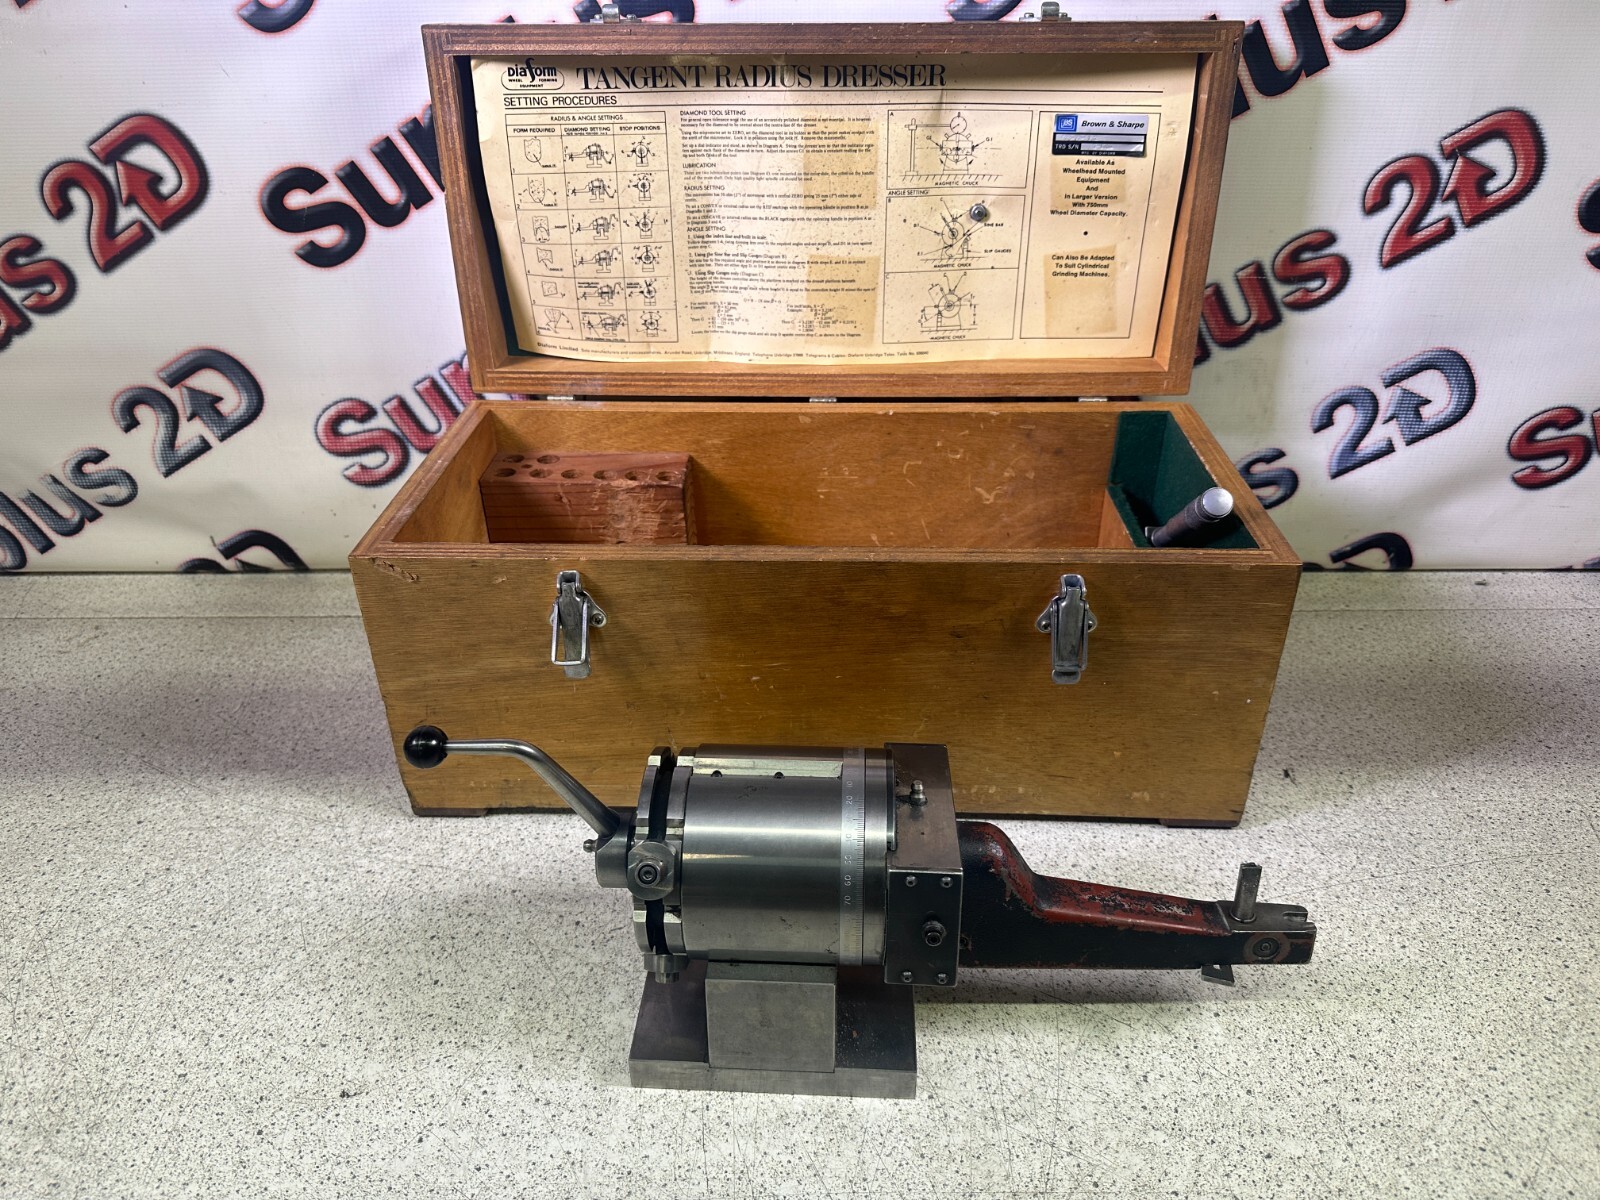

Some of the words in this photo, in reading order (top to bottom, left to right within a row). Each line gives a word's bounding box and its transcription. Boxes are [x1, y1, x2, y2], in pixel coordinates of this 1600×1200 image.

[508, 57, 557, 83] Diaform
[576, 65, 708, 90] TANGENT
[714, 64, 812, 88] RADIUS
[822, 63, 947, 88] DRESSER
[504, 96, 548, 106] SETTING
[552, 96, 617, 106] PROCEDURES
[1117, 121, 1144, 129] Sharpe
[40, 111, 208, 273] 2D
[1362, 107, 1547, 271] 2D
[111, 347, 265, 480] 2D
[1310, 347, 1477, 481] 2D
[846, 795, 853, 805] 20
[844, 875, 851, 886] 60
[844, 895, 851, 905] 70
